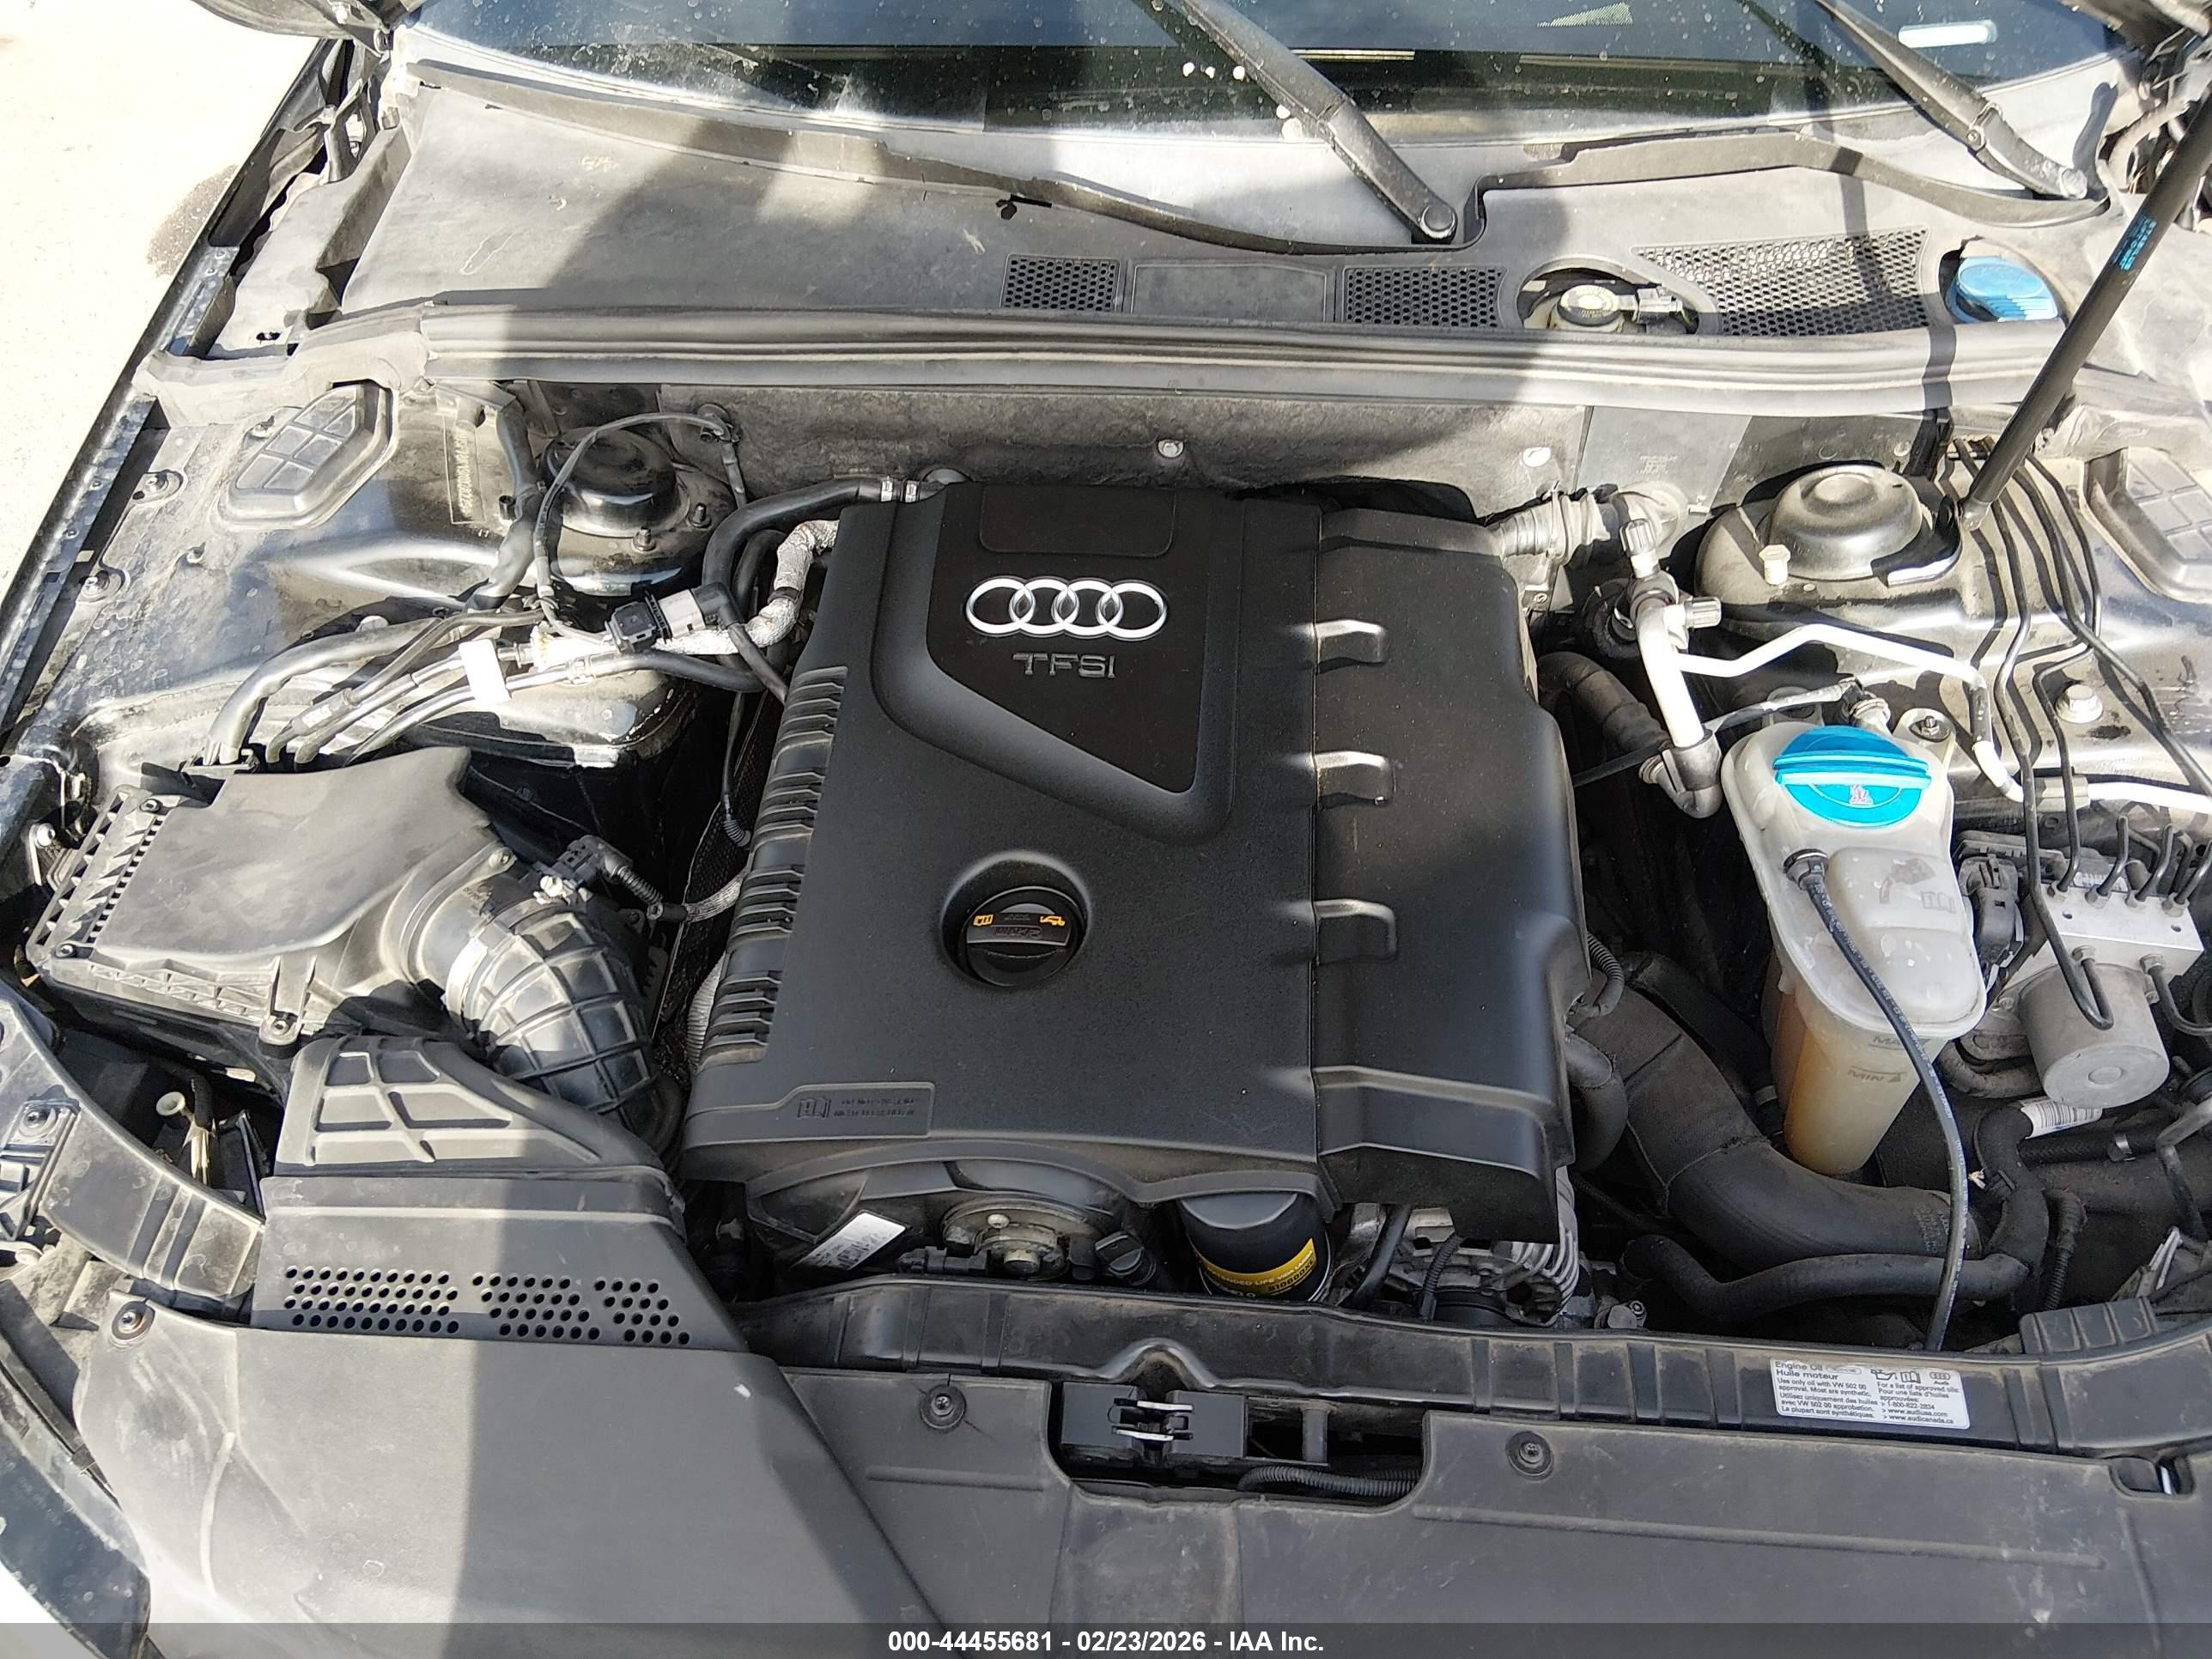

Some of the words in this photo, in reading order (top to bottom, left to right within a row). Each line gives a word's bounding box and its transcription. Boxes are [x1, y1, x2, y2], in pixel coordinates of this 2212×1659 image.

[1012, 652, 1115, 678] TFSI
[1873, 1036, 1902, 1046] MA
[1847, 1069, 1884, 1082] MIN
[1254, 1277, 1275, 1286] LIFE
[1775, 1361, 1808, 1371] Engine
[1810, 1363, 1823, 1371] Oil
[1776, 1369, 1800, 1377] Huile
[1803, 1371, 1839, 1380] moteur
[1805, 1394, 1844, 1403] uniquement
[1887, 1408, 1948, 1418] www.audiusa.com
[1888, 1415, 1954, 1425] www.audicanada.ca
